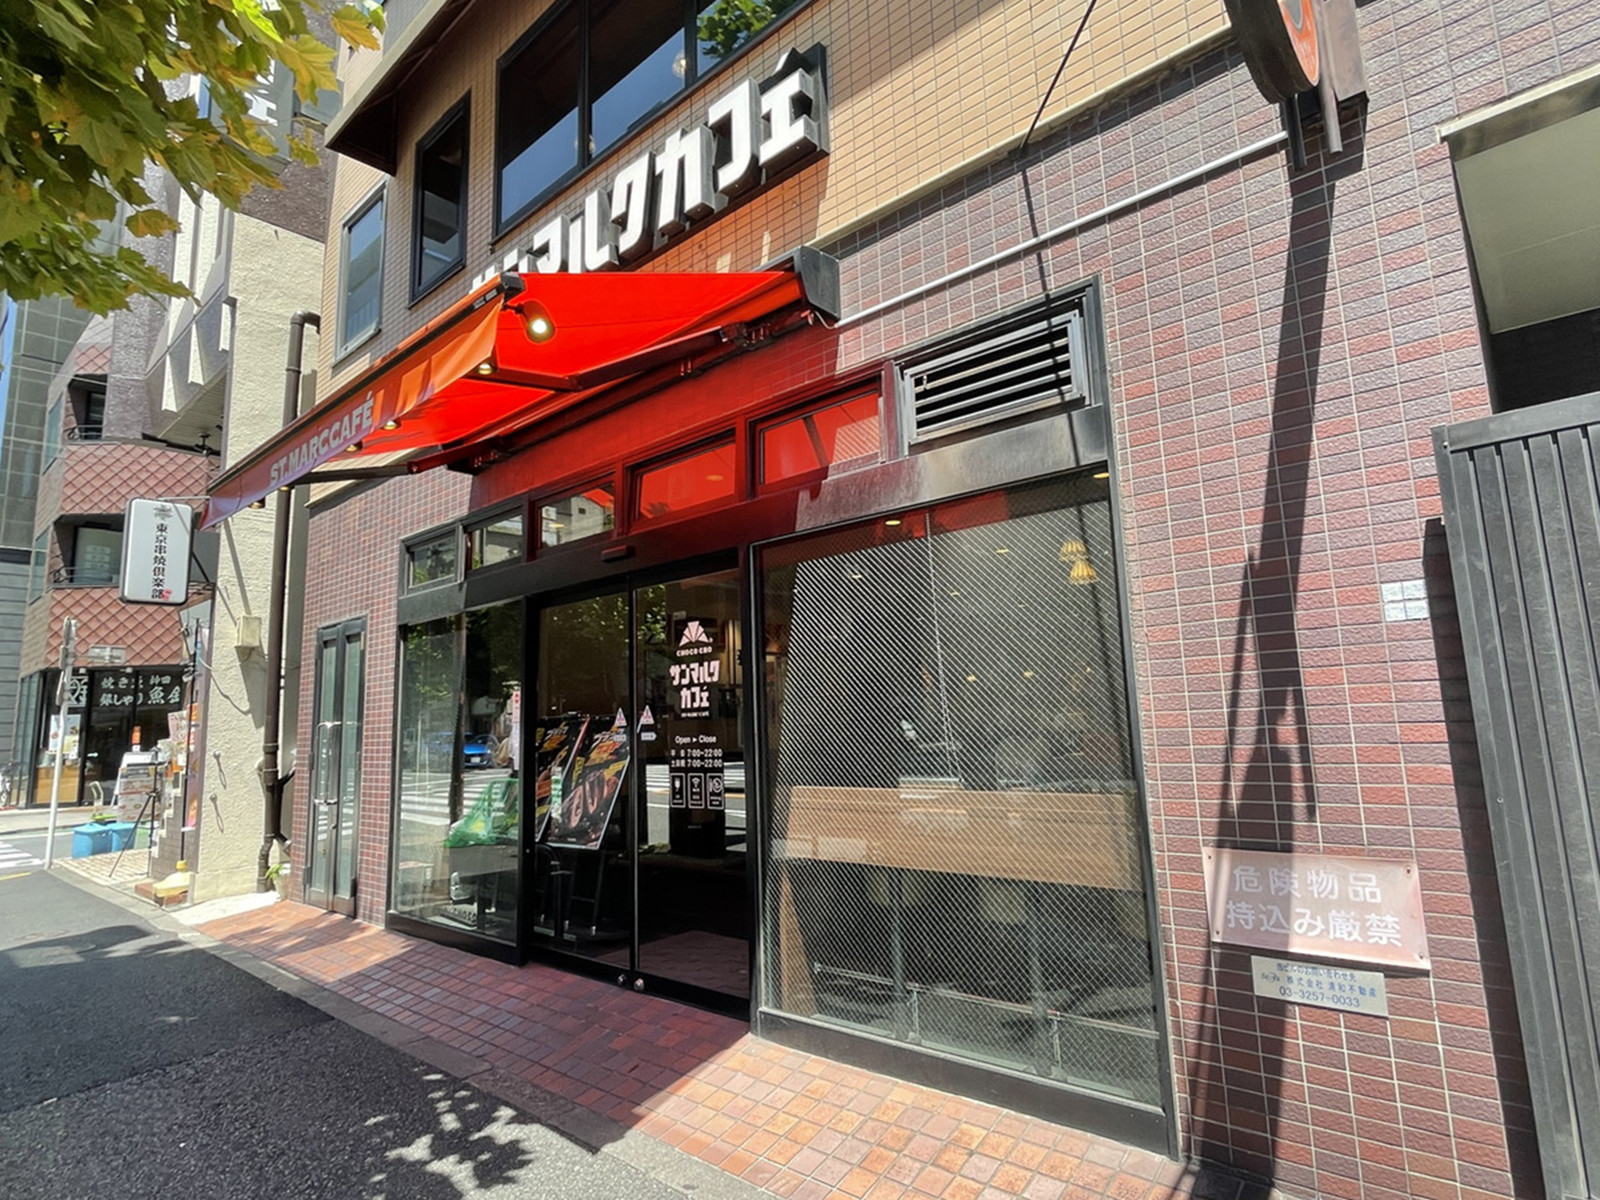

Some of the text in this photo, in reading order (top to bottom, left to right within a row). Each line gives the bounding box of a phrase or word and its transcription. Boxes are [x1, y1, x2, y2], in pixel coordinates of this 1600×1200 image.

[669, 660, 720, 686] サンマルク
[680, 686, 710, 709] カフェ
[674, 734, 717, 745] Open Close
[1231, 865, 1383, 904] 危険物品
[1226, 900, 1403, 947] 持込み厳禁
[1279, 985, 1361, 1008] 03-3257-0033
